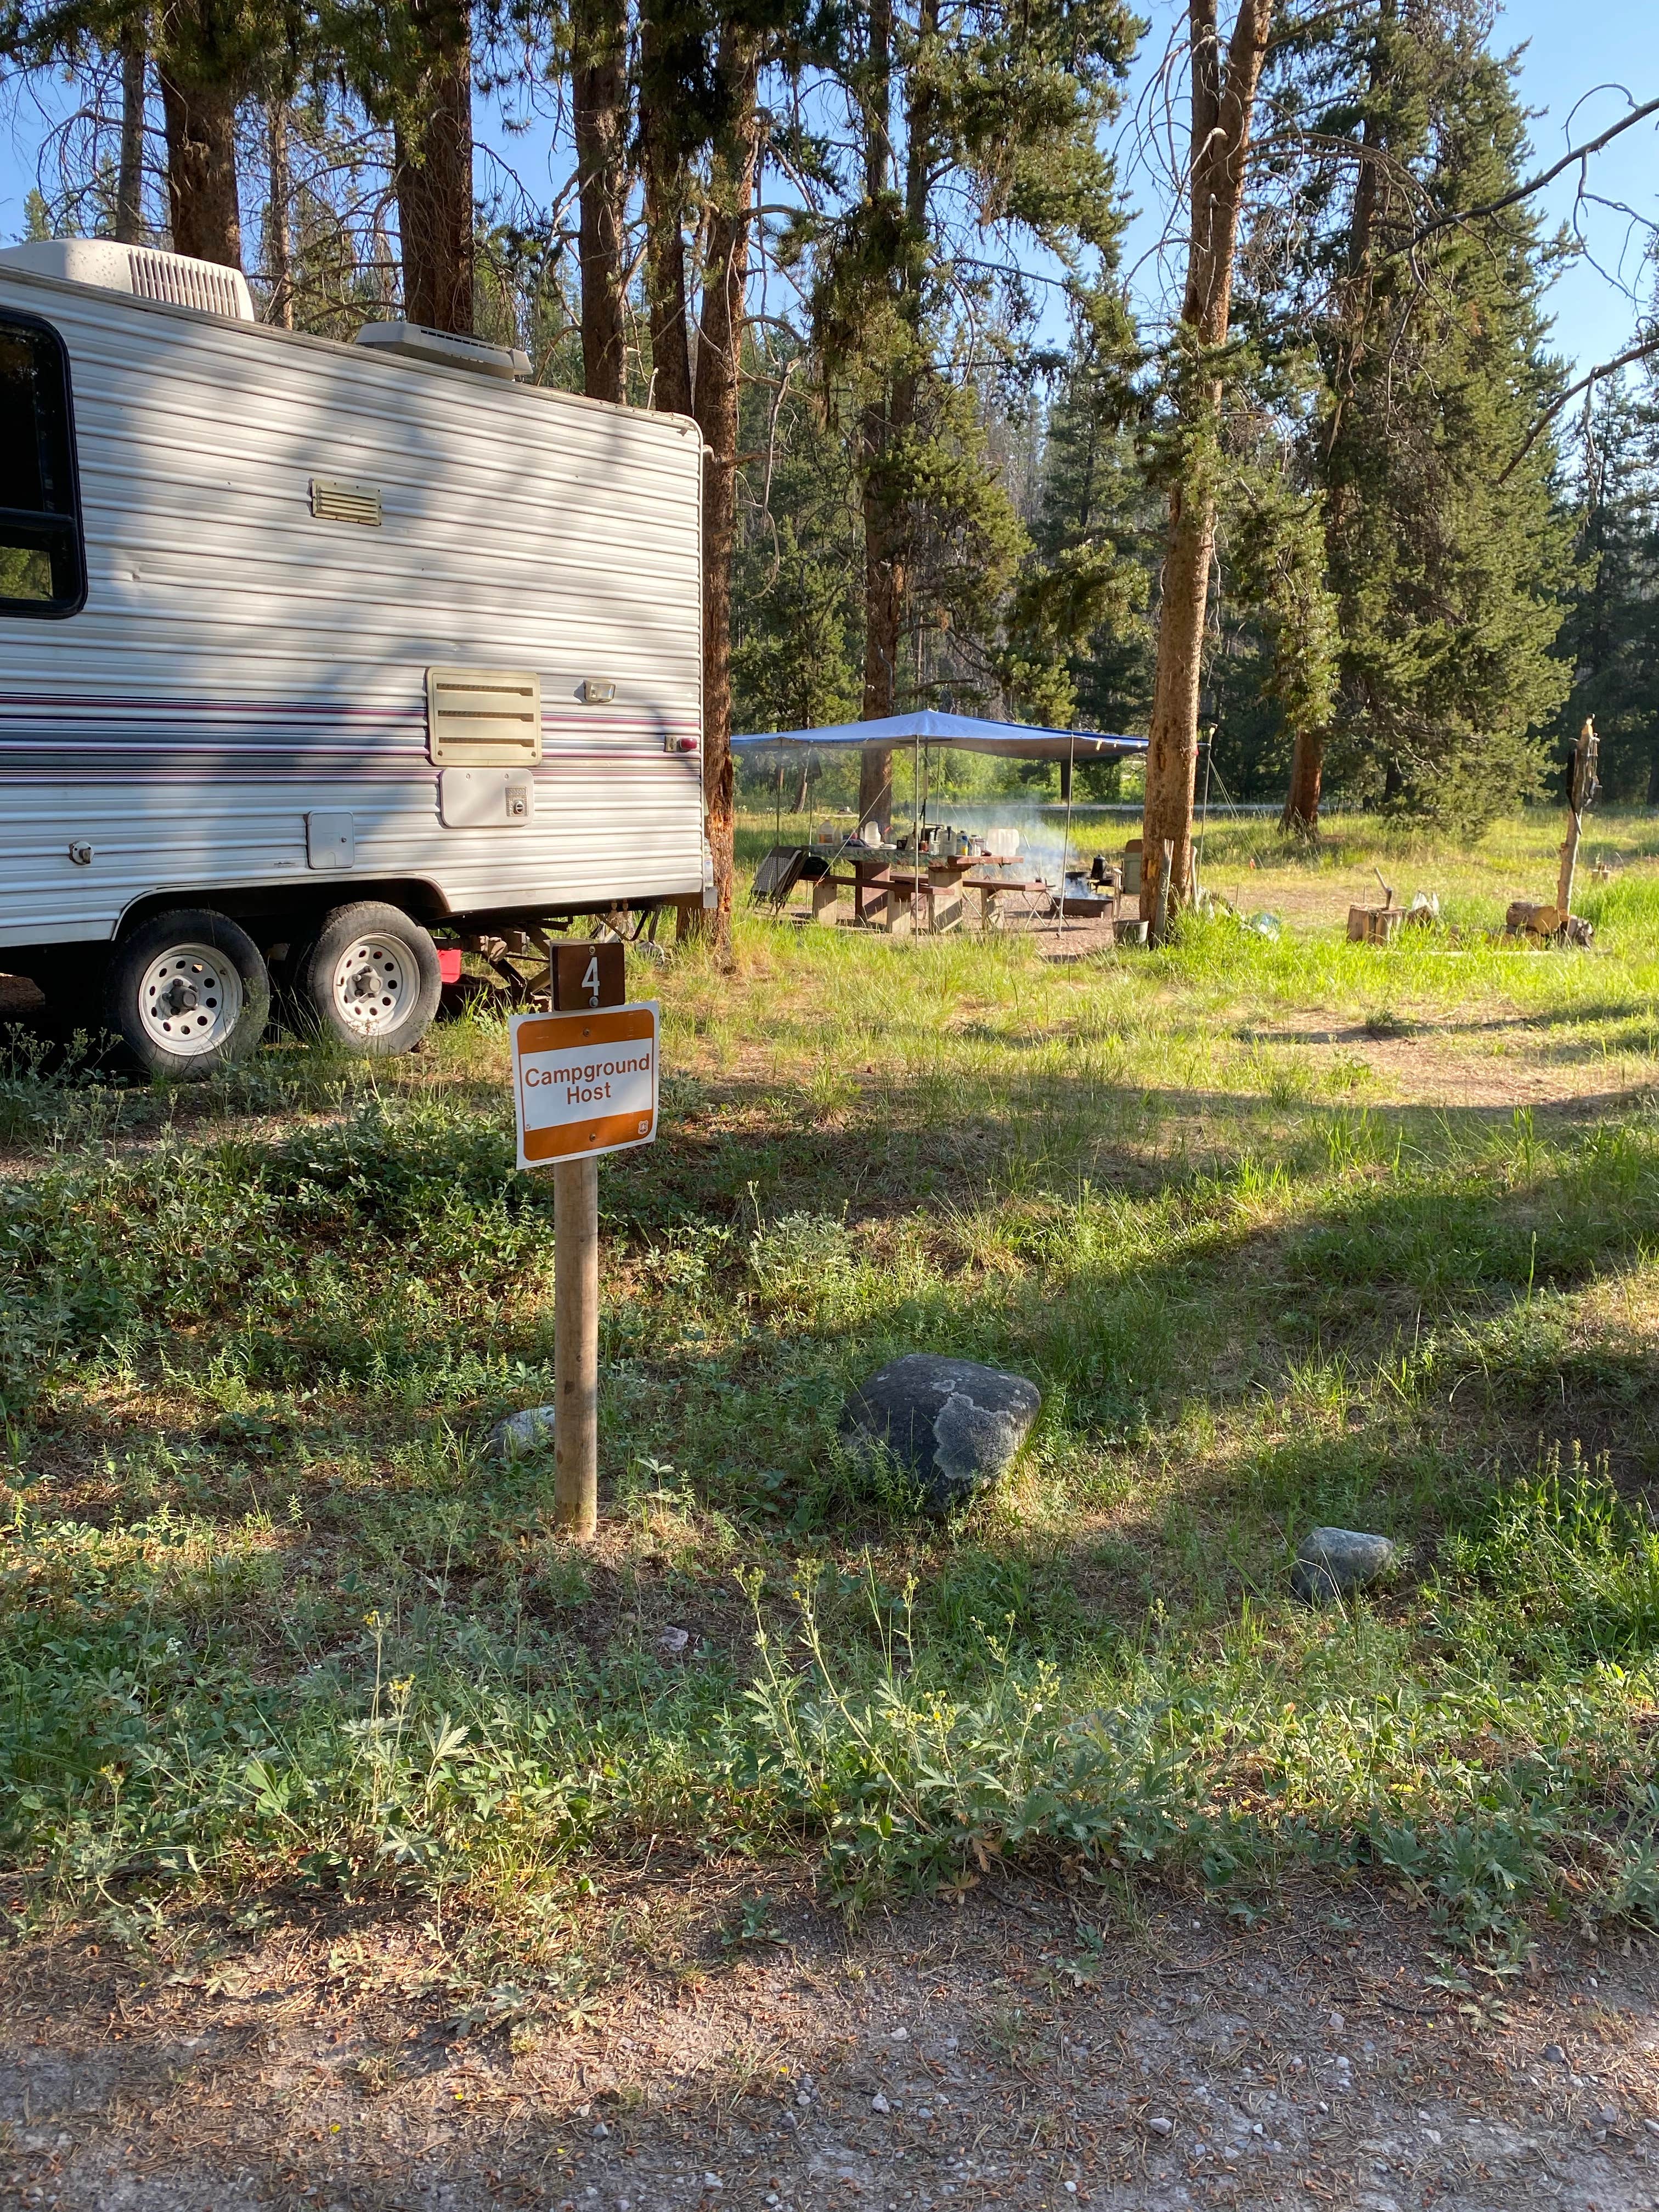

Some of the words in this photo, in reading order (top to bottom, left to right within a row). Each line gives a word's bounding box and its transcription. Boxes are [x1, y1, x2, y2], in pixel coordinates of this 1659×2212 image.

[582, 956, 600, 996] 4
[525, 1053, 650, 1087] Campground
[567, 1082, 611, 1104] Host
